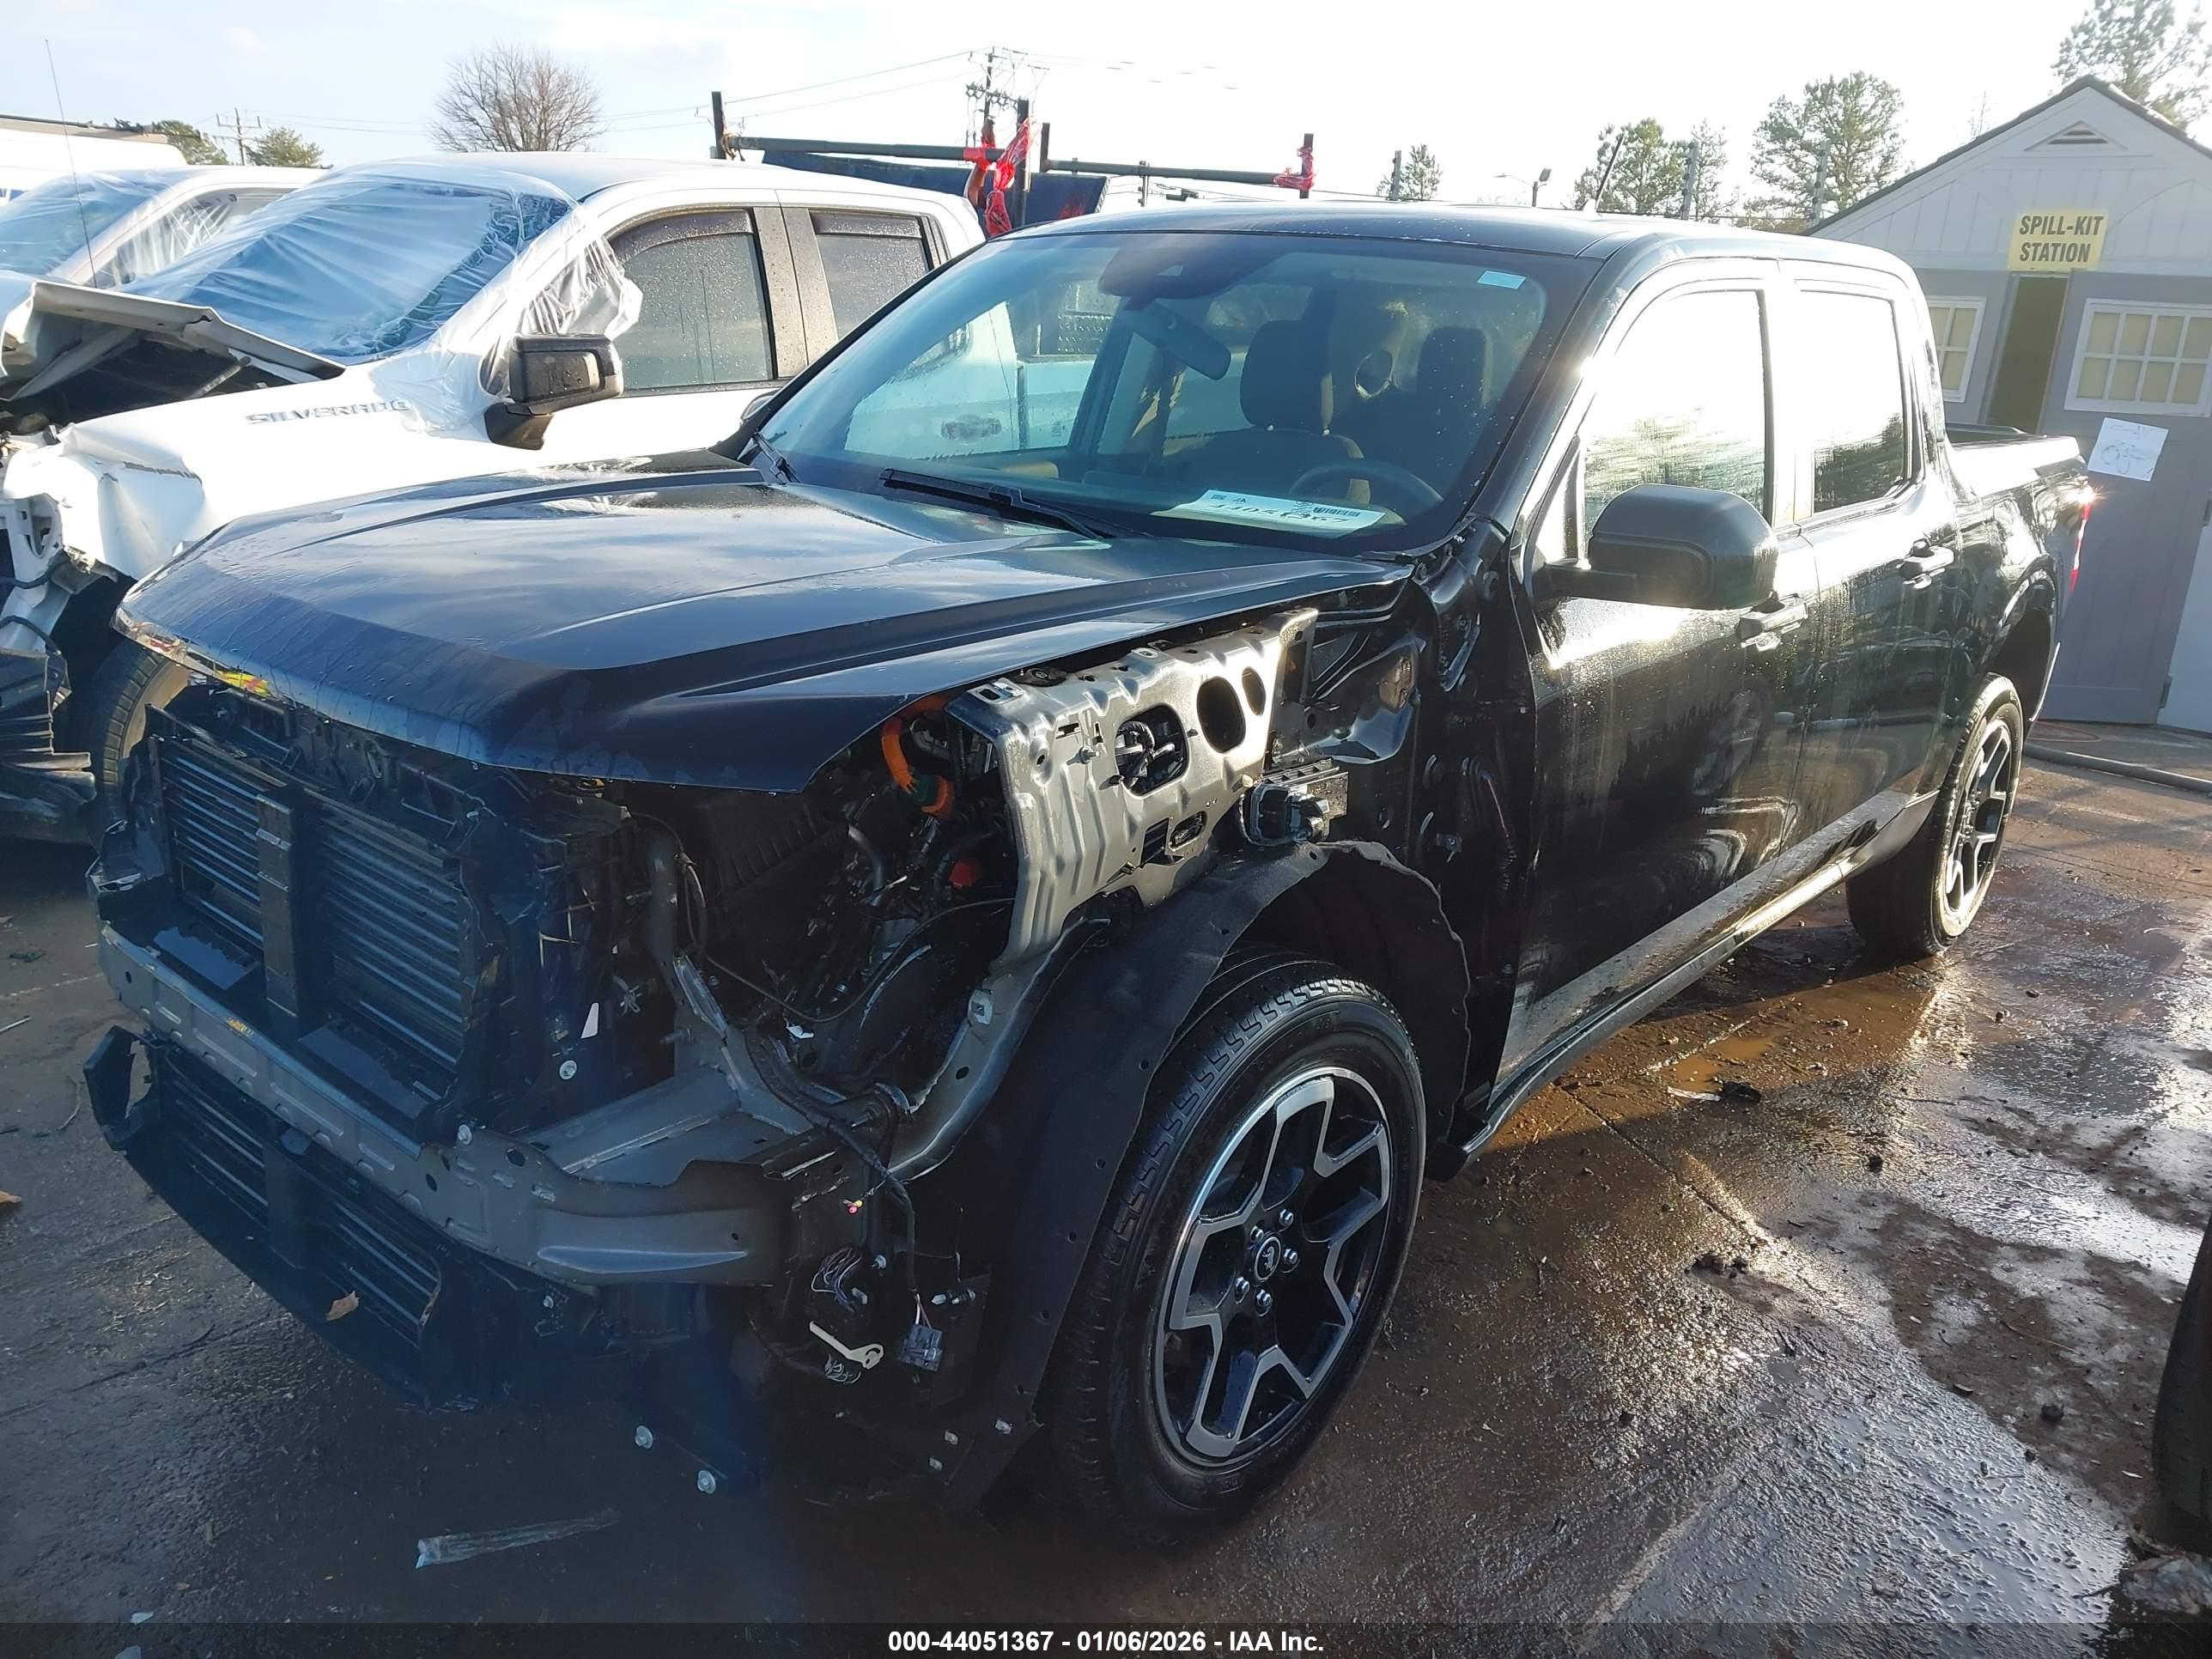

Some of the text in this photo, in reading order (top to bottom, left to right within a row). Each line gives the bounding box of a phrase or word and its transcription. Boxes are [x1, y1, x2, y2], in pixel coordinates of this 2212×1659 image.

[2019, 215, 2105, 235] SPILL-KIT
[2019, 241, 2092, 263] STATION
[245, 399, 410, 424] SILVERADO
